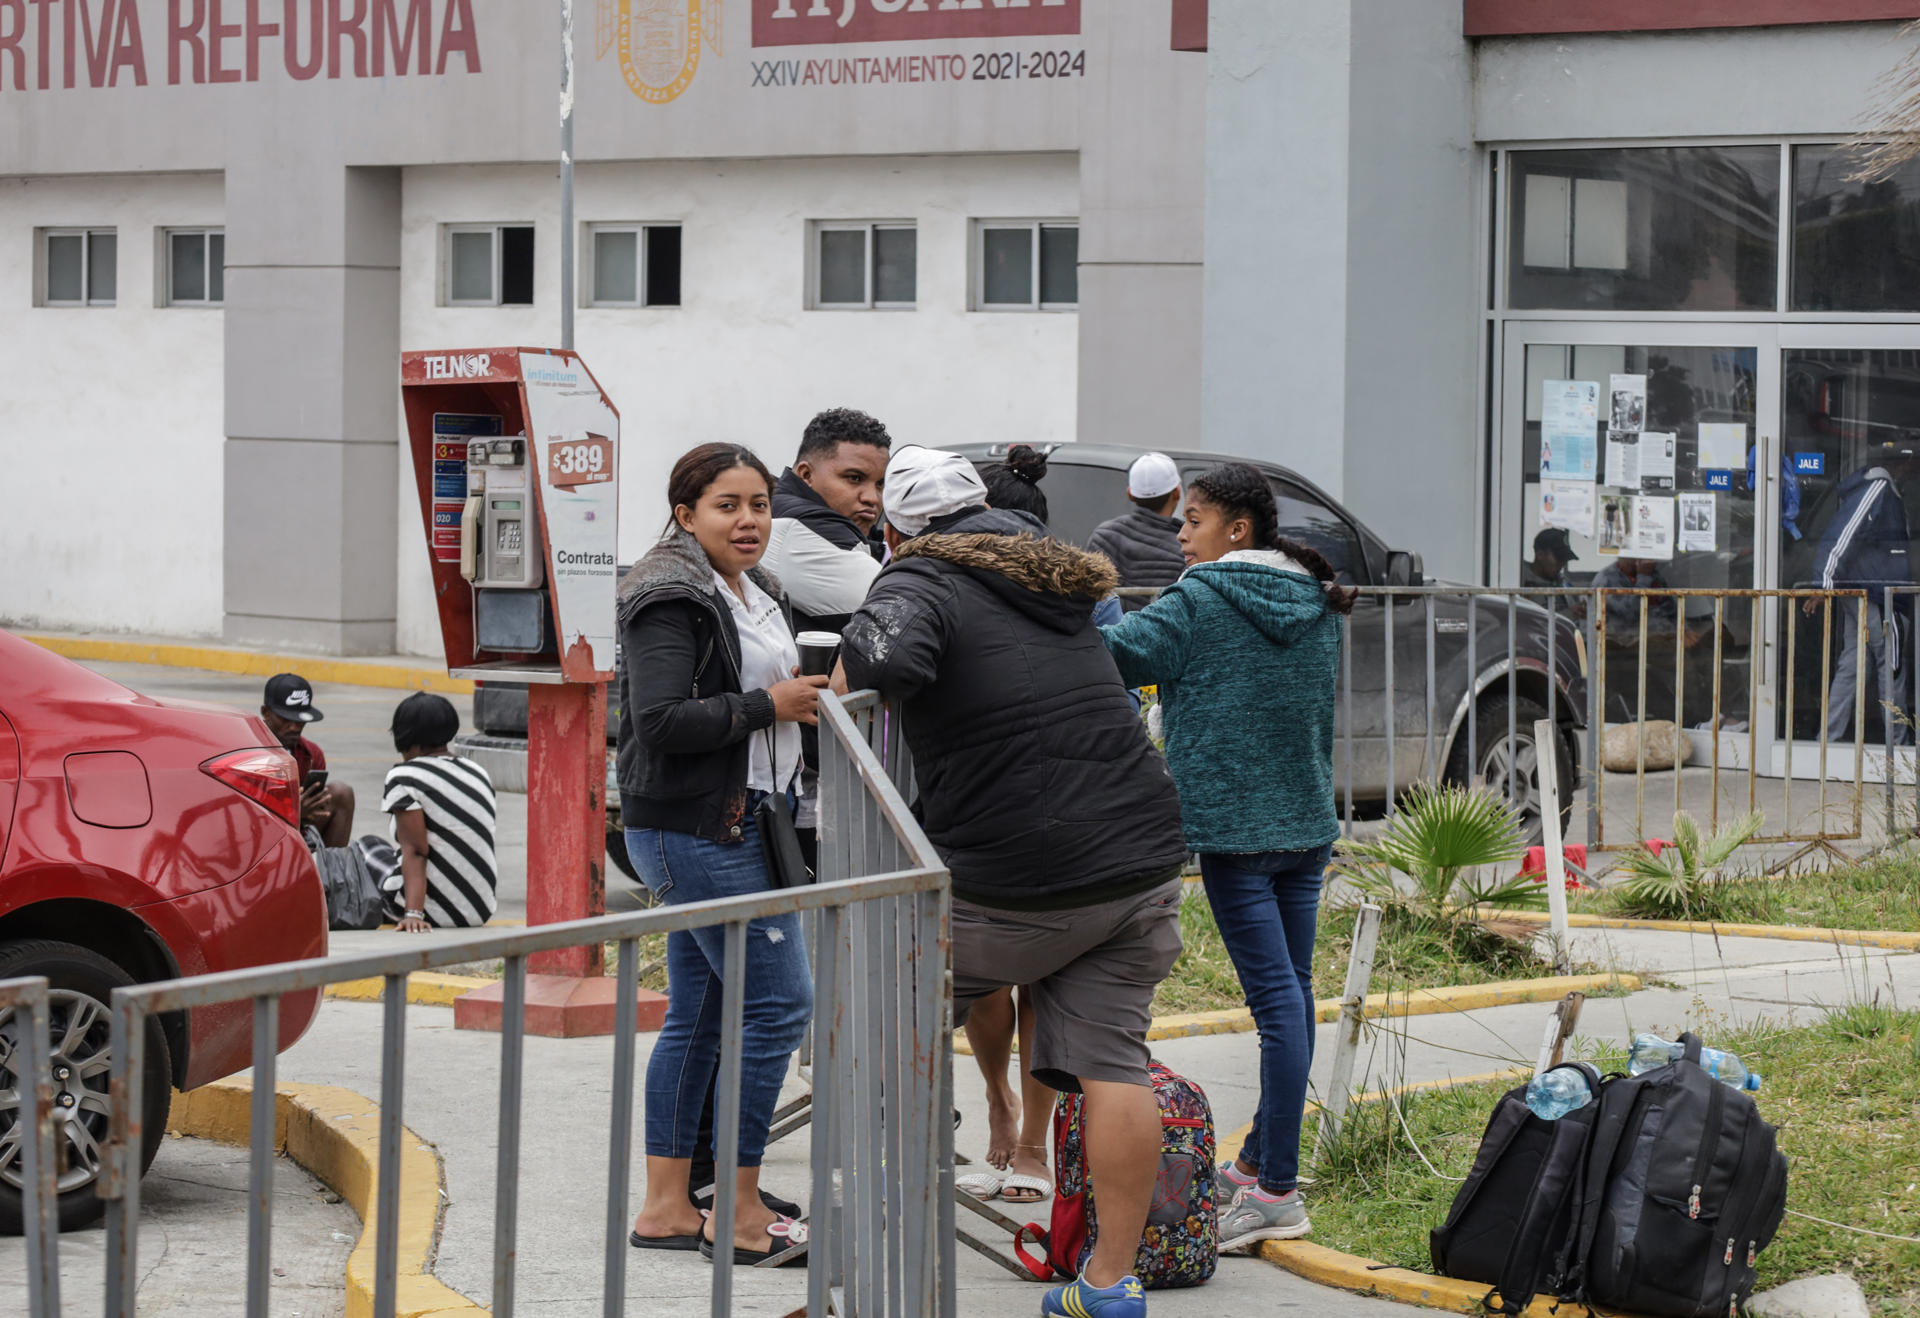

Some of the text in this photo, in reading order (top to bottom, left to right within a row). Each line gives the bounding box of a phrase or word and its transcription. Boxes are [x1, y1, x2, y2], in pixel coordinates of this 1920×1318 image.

[168, 0, 482, 85] REFORMA
[751, 50, 1086, 87] XXIV AYUNTAMIENTO 2021-2024
[423, 354, 490, 380] TELNOR
[553, 444, 602, 474] $389
[1798, 458, 1819, 469] JALE
[1709, 475, 1729, 486] JALE
[557, 550, 614, 565] Contrata
